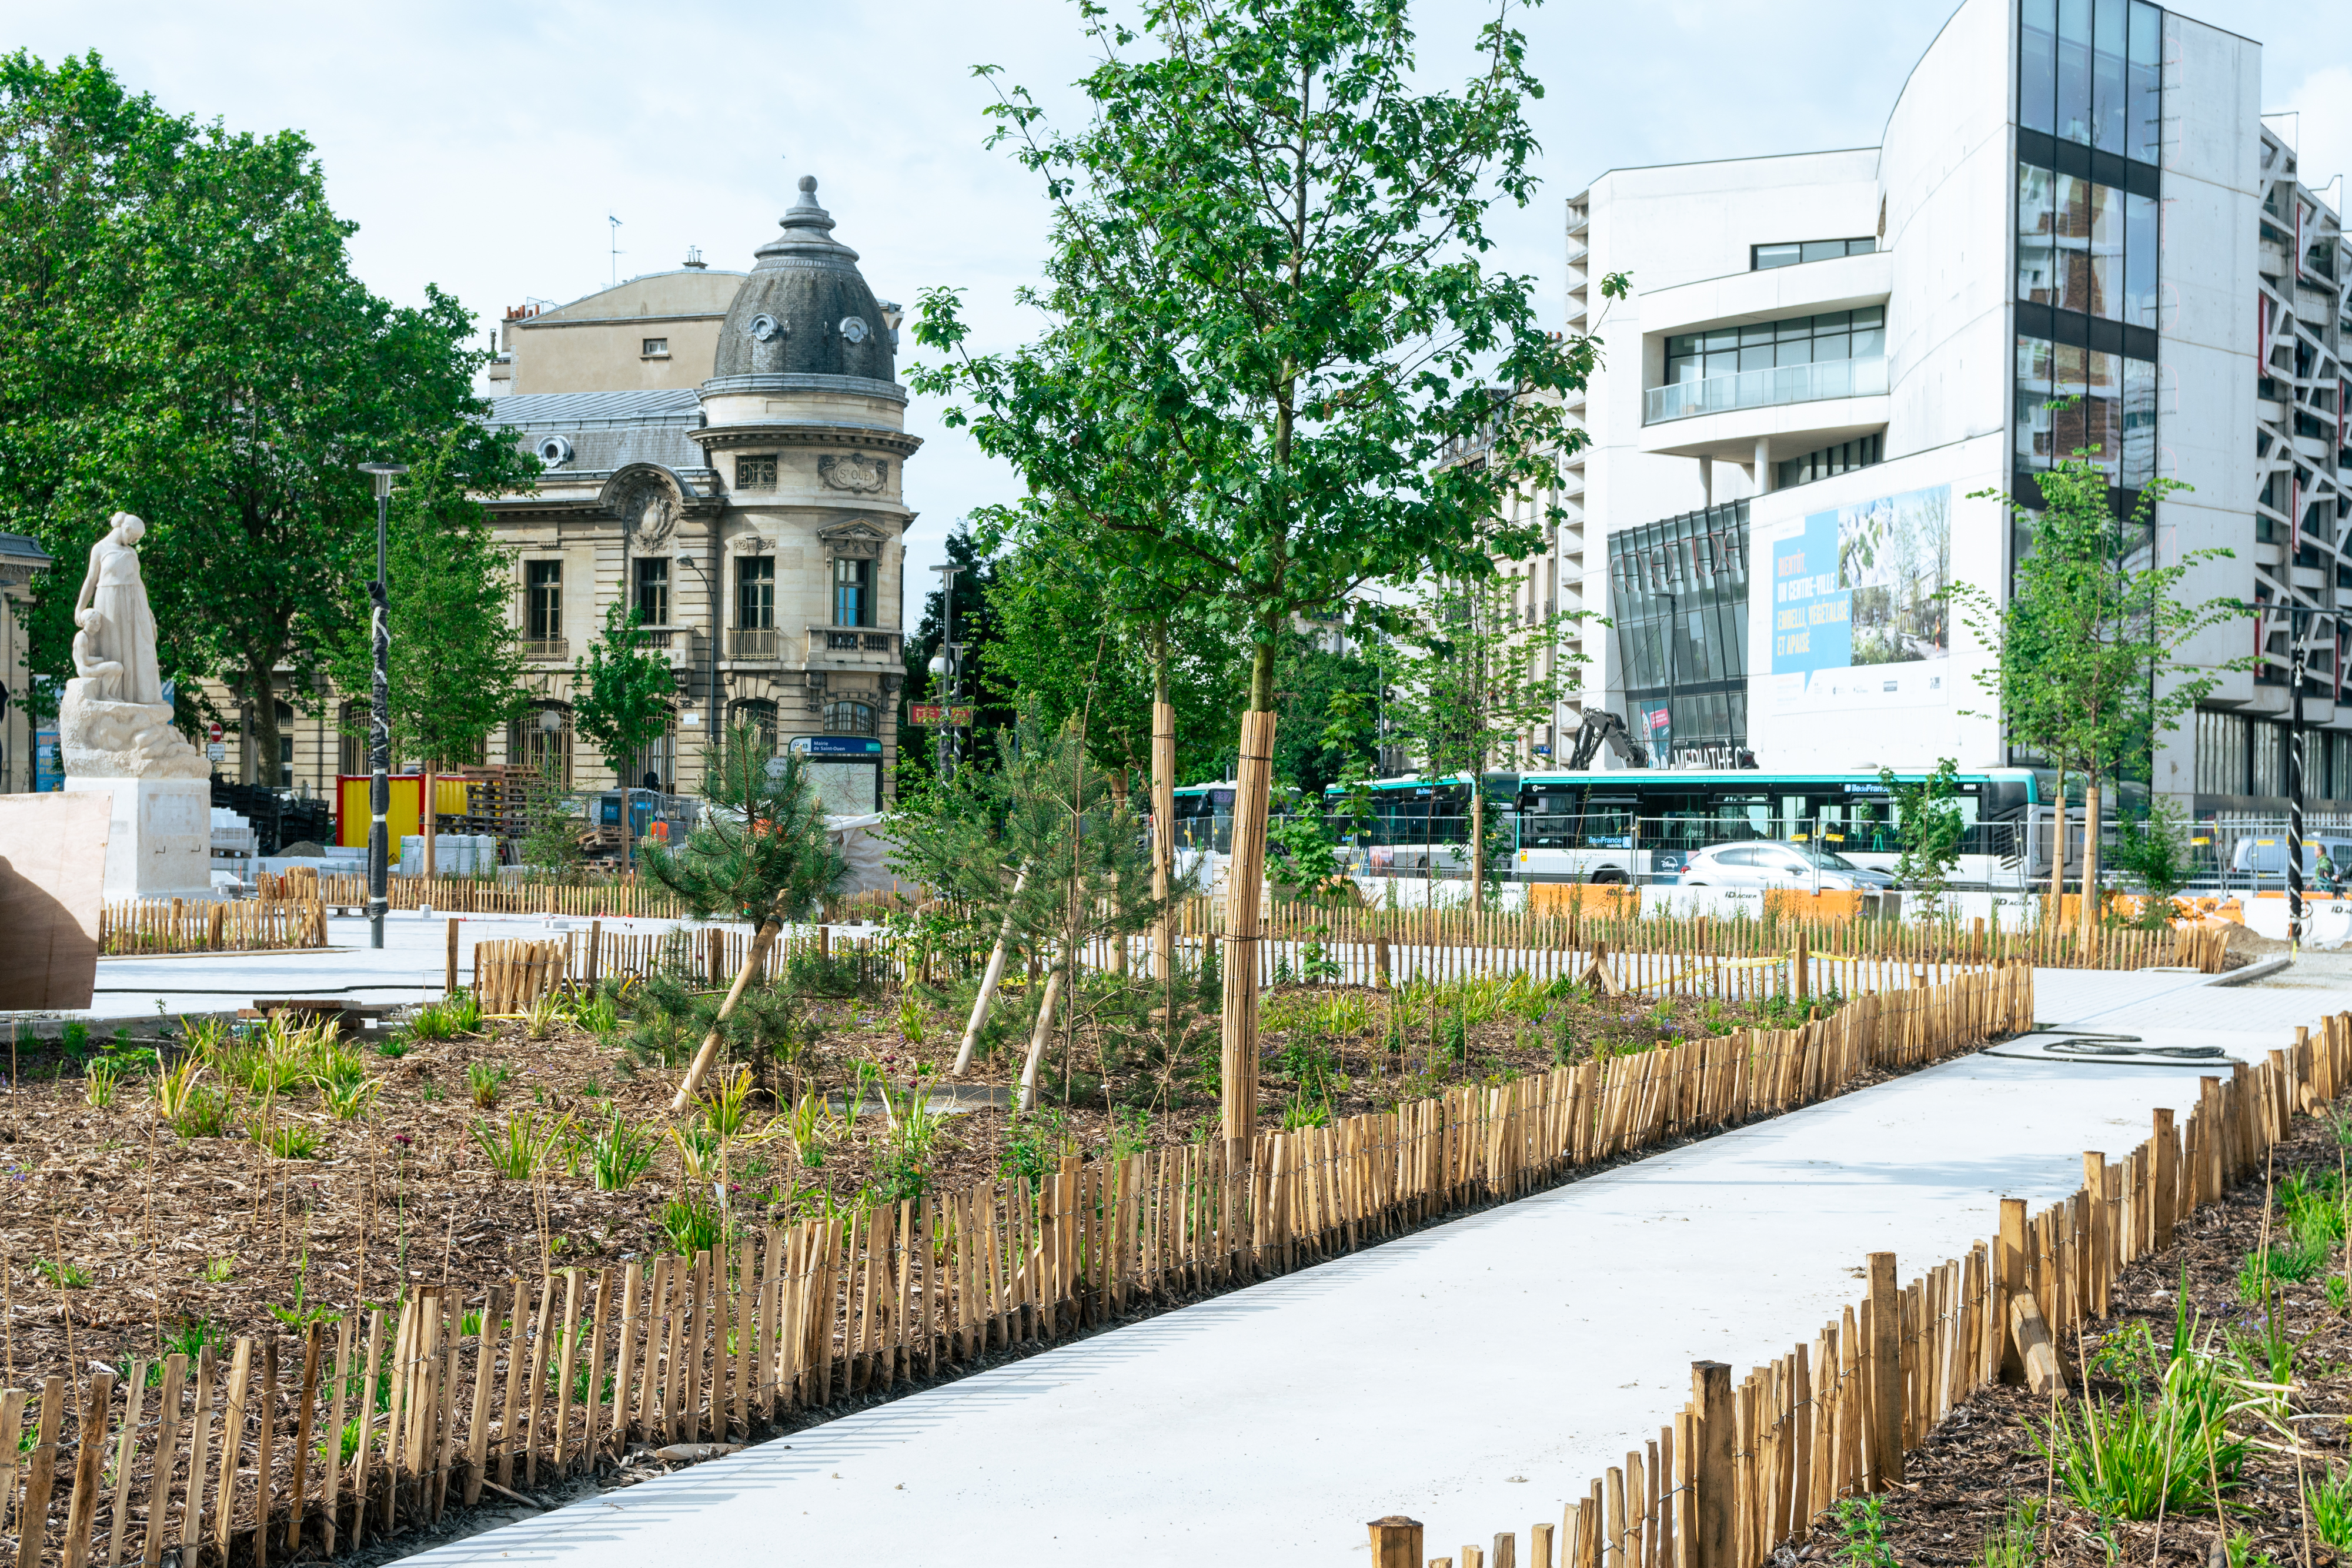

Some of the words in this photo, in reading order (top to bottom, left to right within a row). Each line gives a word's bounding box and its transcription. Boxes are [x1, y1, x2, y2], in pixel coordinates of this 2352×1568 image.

[851, 470, 875, 481] OUEN
[1778, 549, 1806, 577] BIENTÔT,
[1778, 581, 1787, 603] UN
[1788, 572, 1835, 601] CENTRE-VILLE
[1778, 607, 1806, 630] EMBELLI,
[1808, 594, 1849, 626] VÉGÉTALISÉ
[1778, 636, 1785, 656] ET
[1786, 627, 1810, 655] APAISÉ
[1214, 793, 1231, 801] 237
